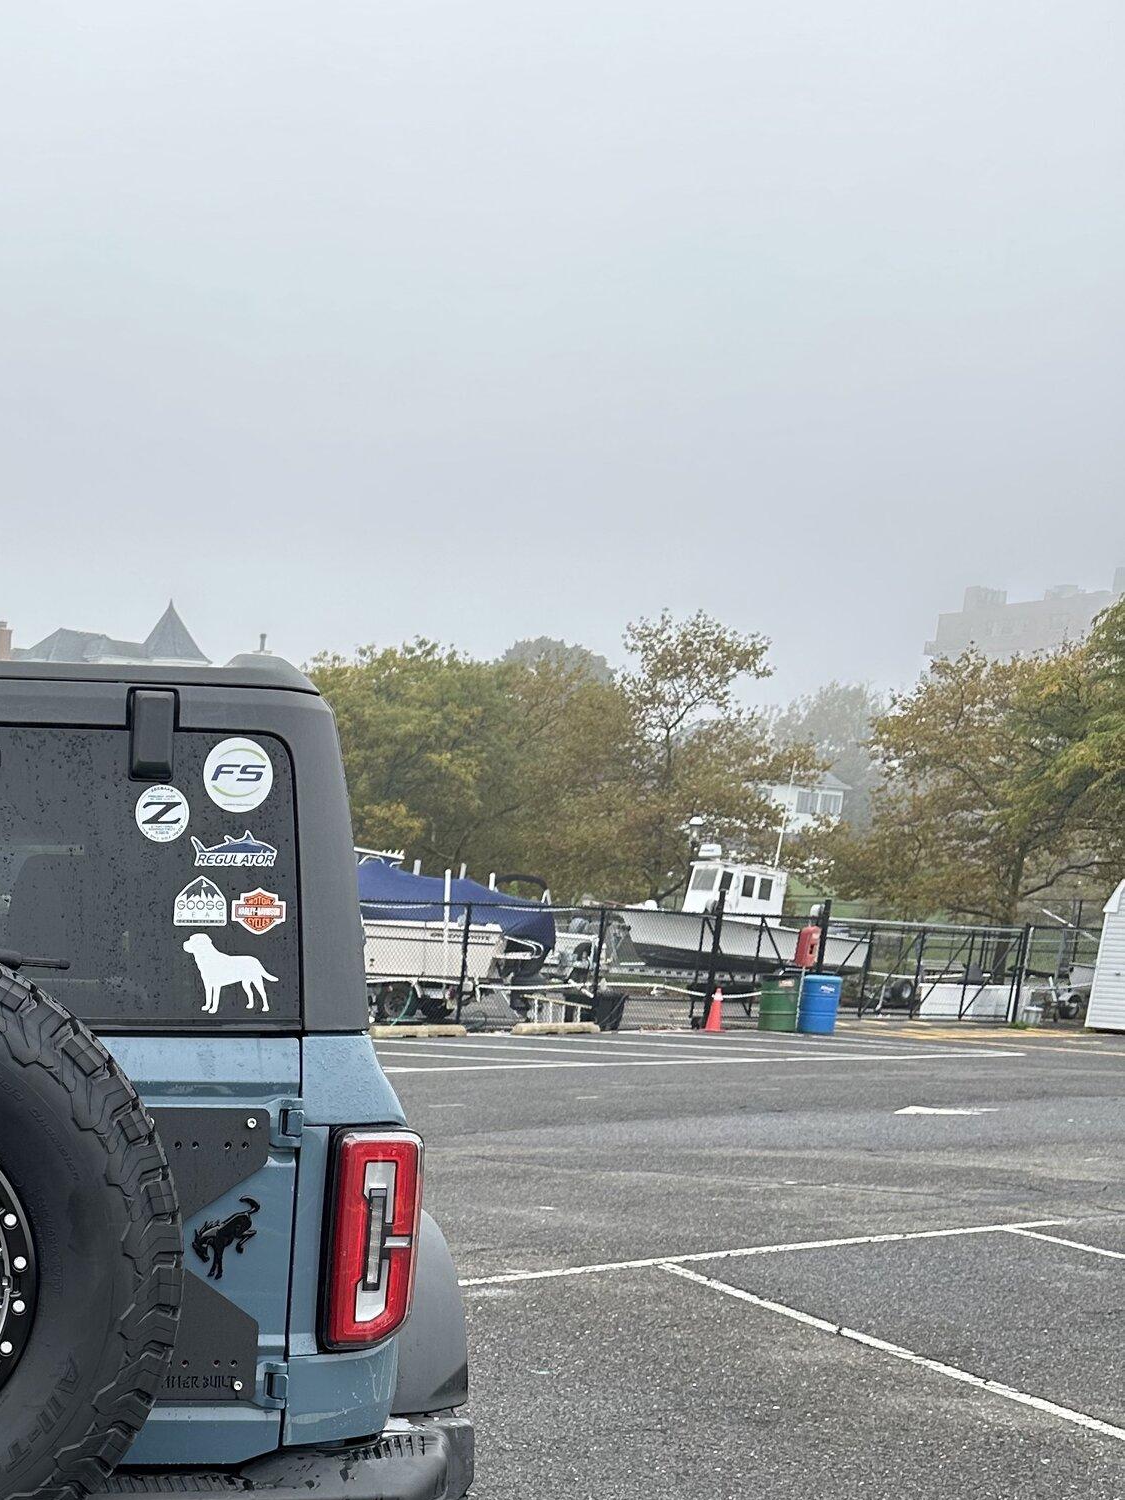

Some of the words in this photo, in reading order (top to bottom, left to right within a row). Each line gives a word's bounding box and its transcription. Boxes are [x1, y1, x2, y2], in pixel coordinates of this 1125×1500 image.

[211, 764, 266, 781] FS
[142, 802, 182, 824] Z
[197, 853, 275, 866] REGULATOR
